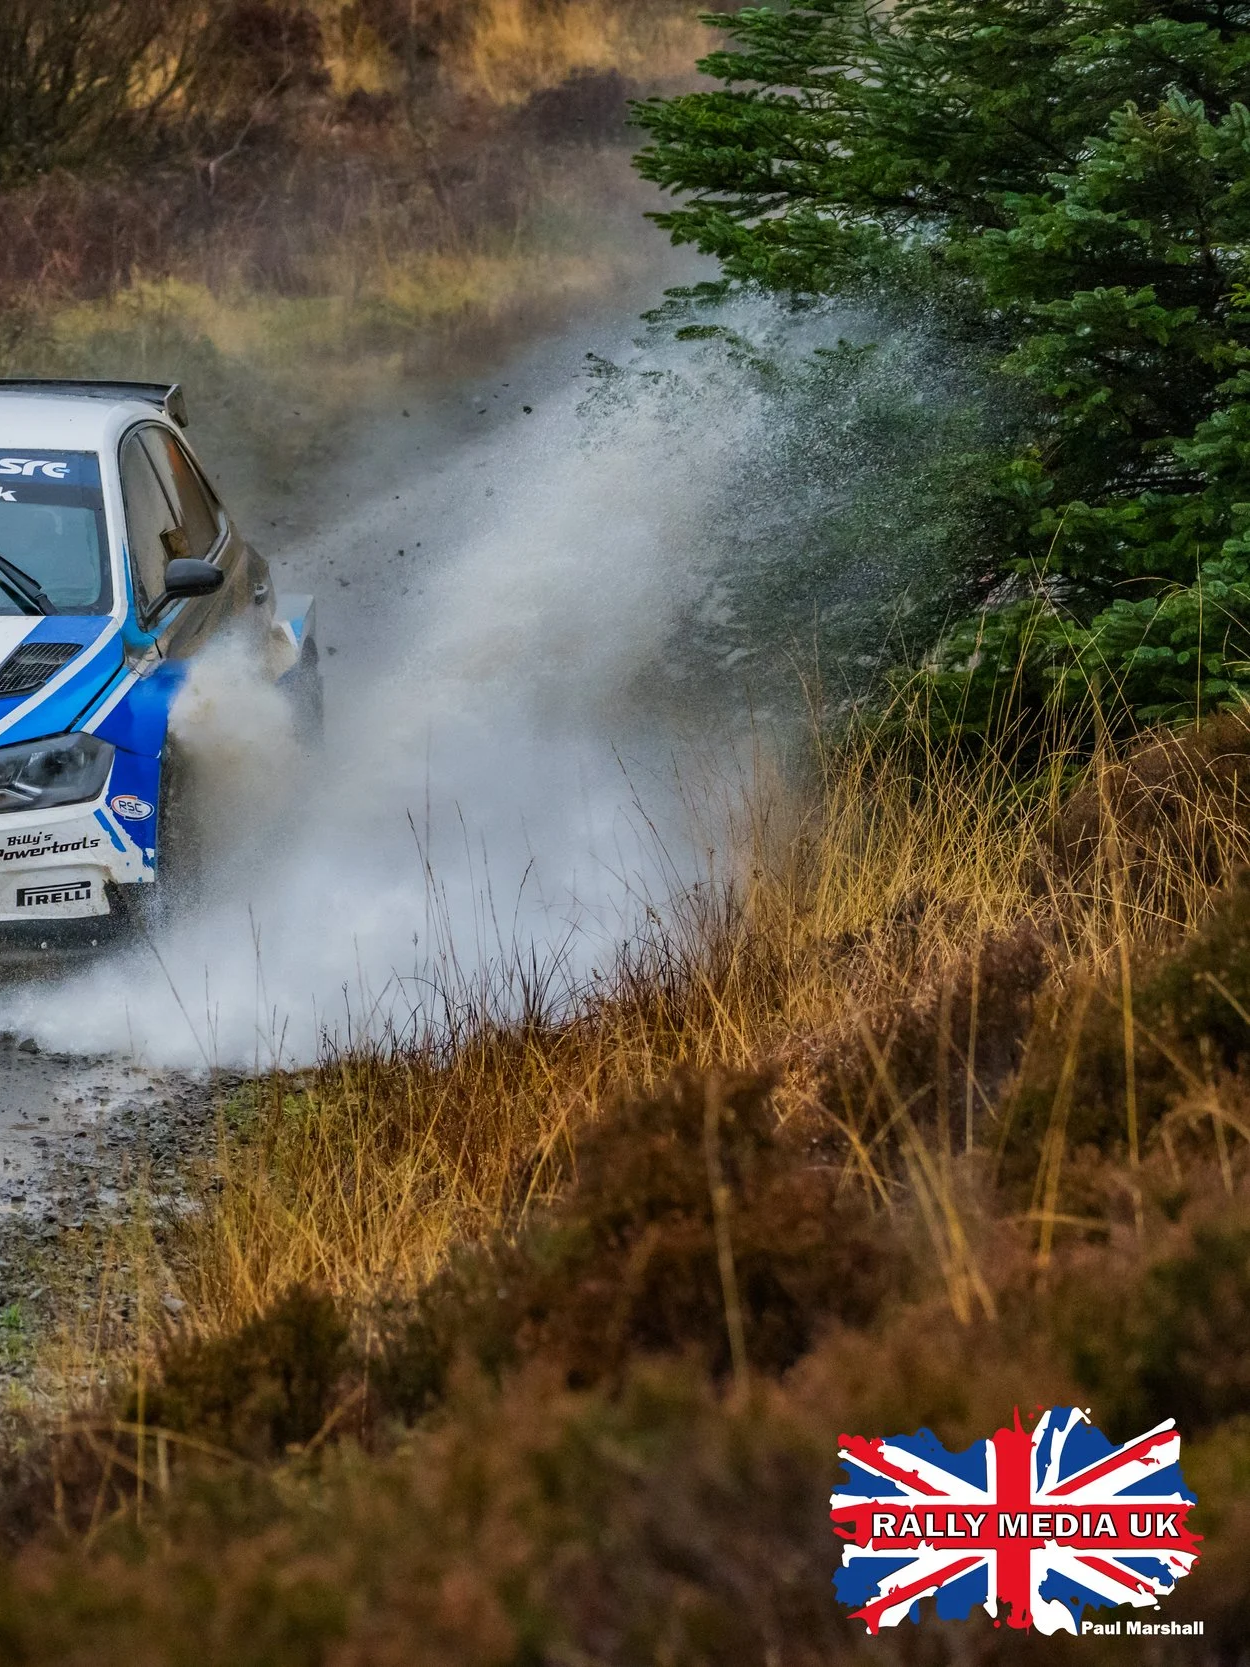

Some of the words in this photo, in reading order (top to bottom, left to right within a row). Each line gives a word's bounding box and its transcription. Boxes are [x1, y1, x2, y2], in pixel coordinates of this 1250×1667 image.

[118, 800, 143, 813] RSC
[7, 831, 54, 846] Billy's
[16, 881, 91, 907] PIRELLI
